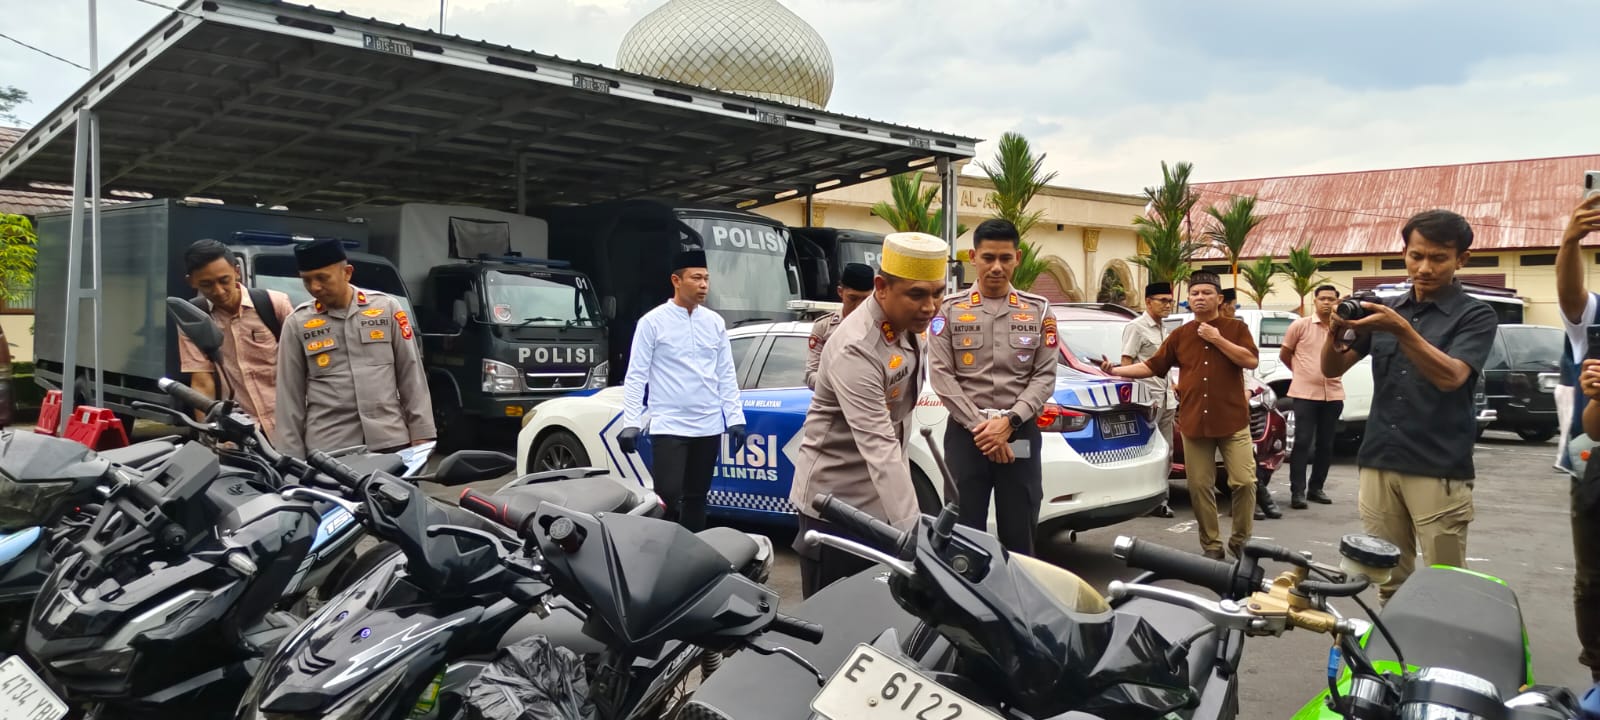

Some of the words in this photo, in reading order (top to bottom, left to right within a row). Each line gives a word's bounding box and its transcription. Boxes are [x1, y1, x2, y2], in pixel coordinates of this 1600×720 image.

[575, 276, 589, 290] 01
[360, 318, 389, 327] POLRI
[1010, 324, 1037, 332] POLRI
[303, 326, 331, 341] DENY
[518, 347, 594, 363] POLISI
[720, 433, 777, 467] LISI
[722, 467, 778, 481] LINTAS
[2, 673, 39, 707] 4734
[845, 653, 874, 683] E
[881, 672, 962, 720] 6122
